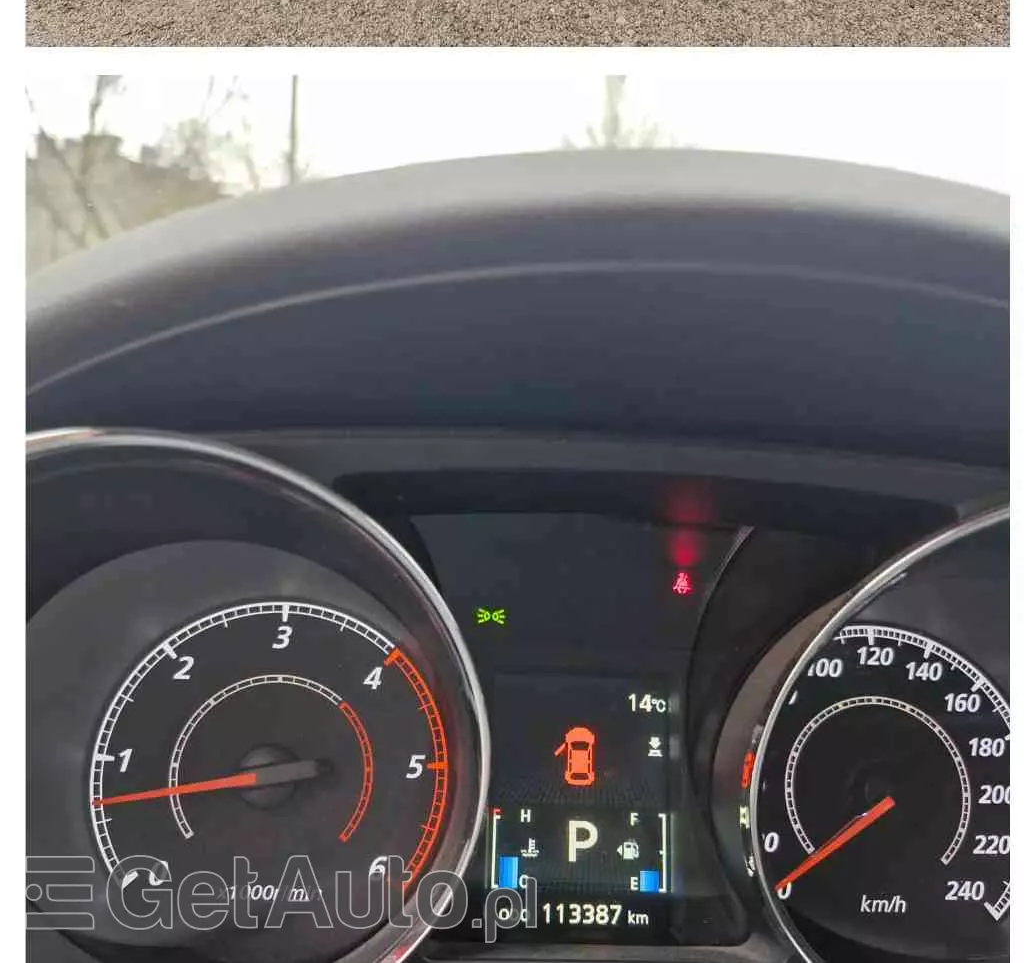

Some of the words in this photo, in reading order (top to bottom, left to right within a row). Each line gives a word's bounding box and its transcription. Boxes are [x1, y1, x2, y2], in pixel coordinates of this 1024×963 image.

[272, 625, 293, 650] 3
[857, 647, 894, 666] 120
[173, 655, 194, 681] 2
[363, 666, 384, 690] 4
[905, 662, 943, 681] 140
[945, 693, 981, 713] 160
[969, 737, 1005, 757] 180
[114, 747, 133, 773] 1
[405, 753, 426, 779] 5
[520, 809, 532, 823] H
[630, 813, 639, 826] F
[568, 820, 598, 863] P
[972, 835, 1010, 855] 220
[148, 859, 170, 886] 0
[367, 856, 387, 882] 6
[630, 877, 639, 891] E
[945, 881, 985, 901] 240
[542, 904, 623, 925] 113387
[627, 909, 649, 925] km
[860, 895, 907, 914] km/h
